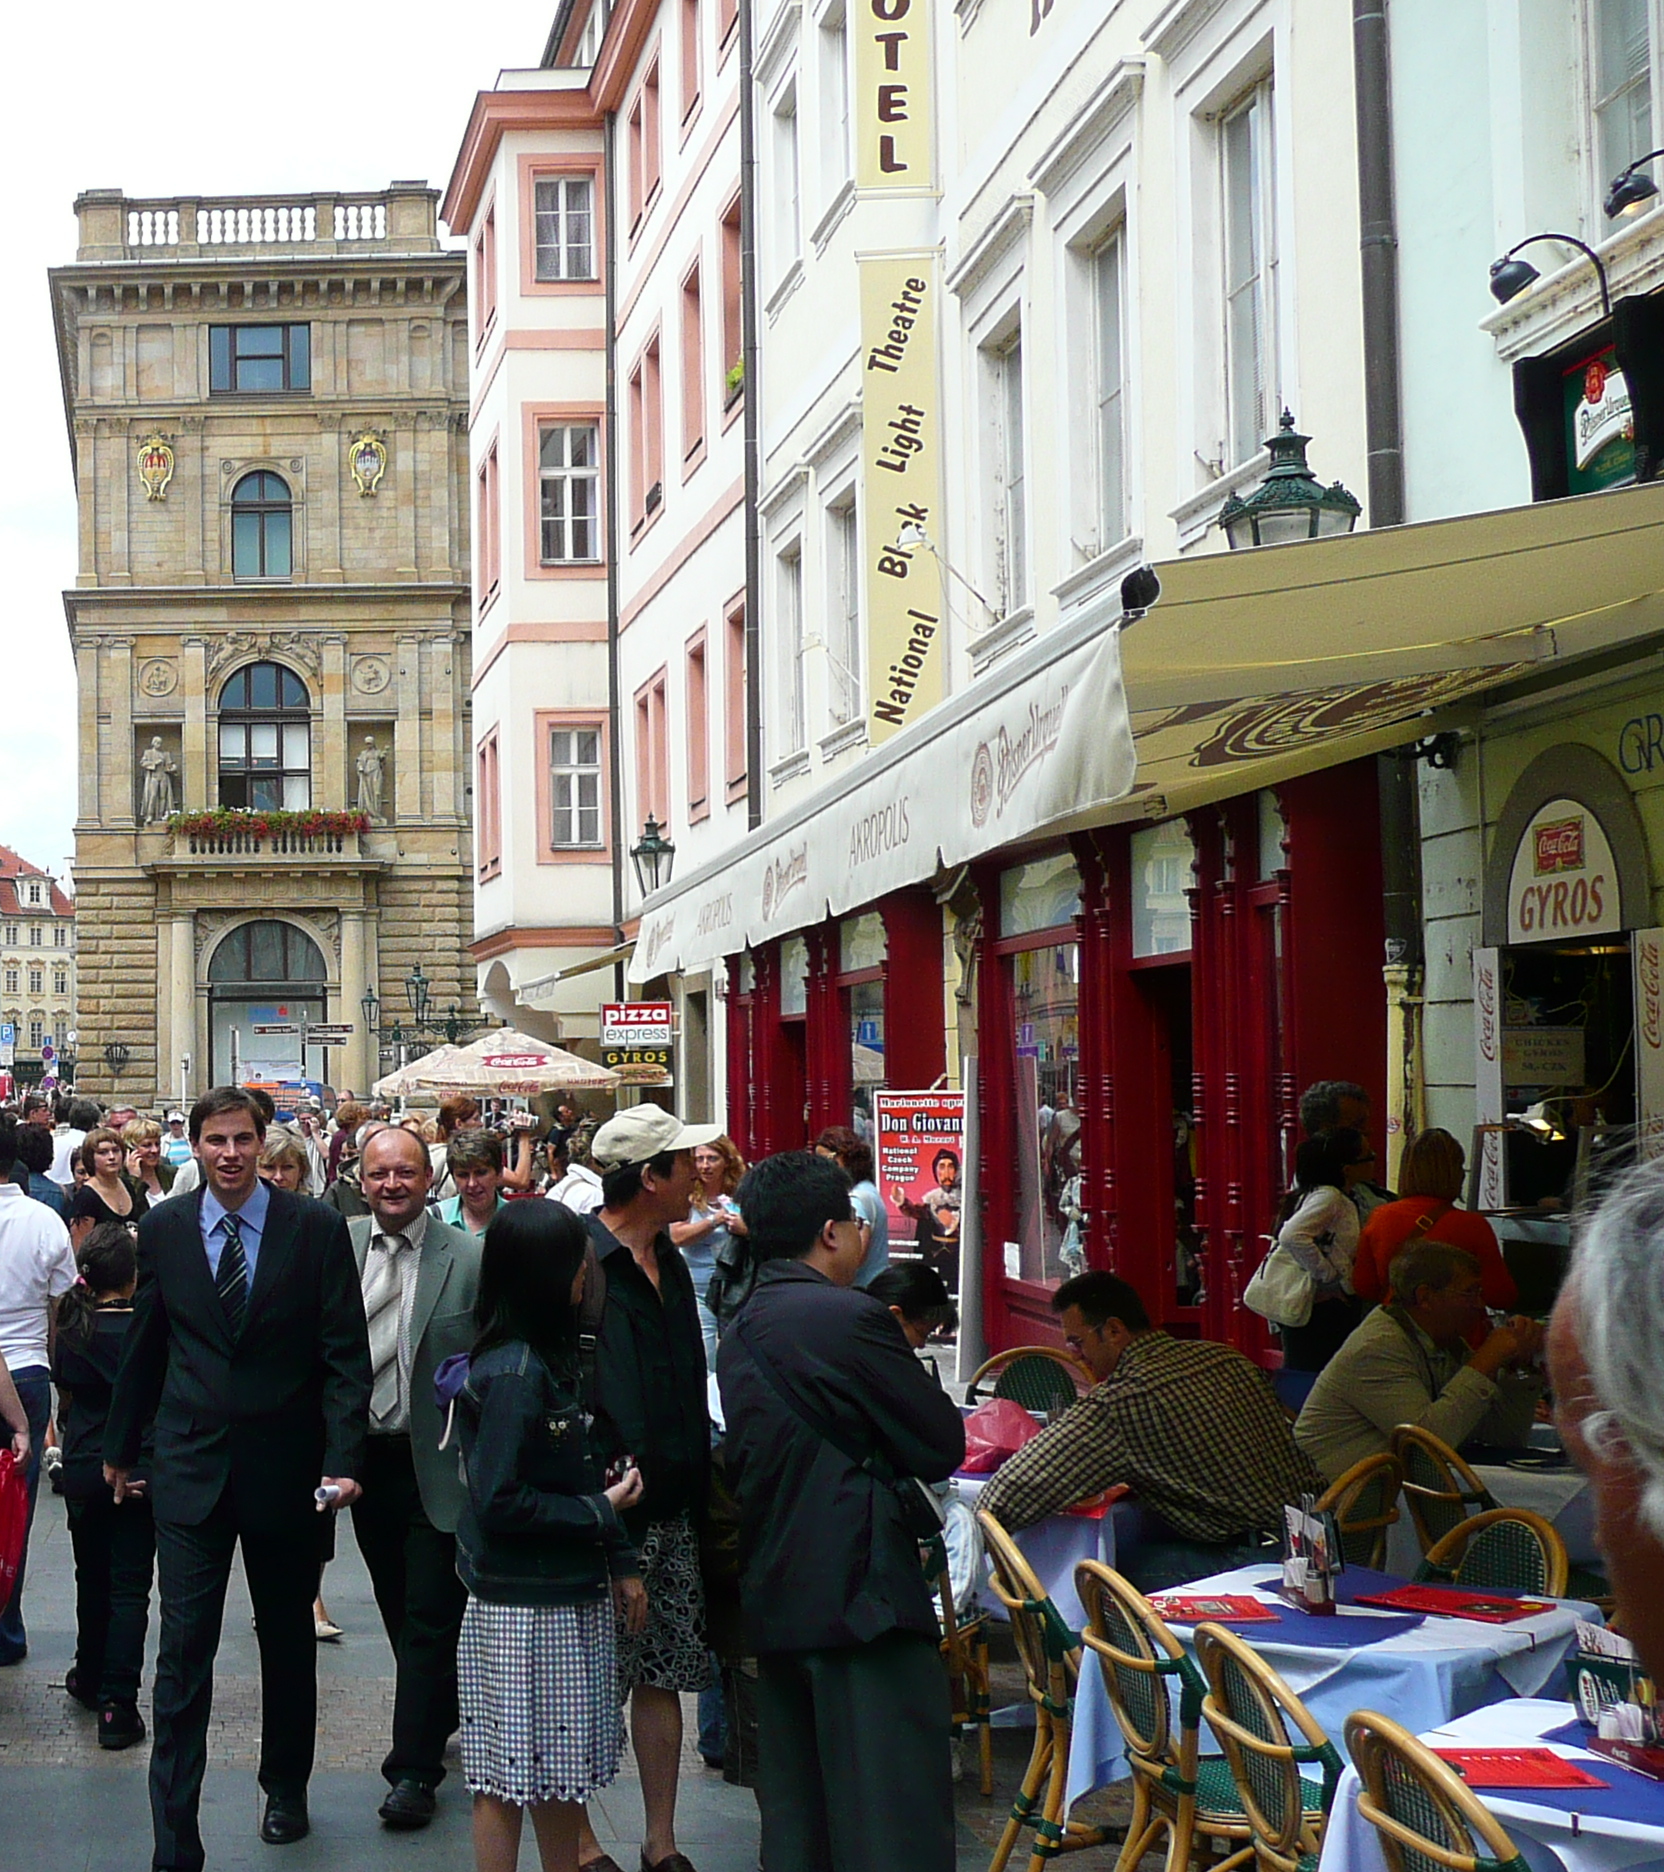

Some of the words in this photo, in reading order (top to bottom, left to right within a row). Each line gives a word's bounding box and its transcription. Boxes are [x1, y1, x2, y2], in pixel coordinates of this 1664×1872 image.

[867, 277, 926, 372] Theatre
[875, 404, 925, 473] Light
[874, 609, 939, 725] National
[849, 796, 909, 868] AKROPOLIS
[1519, 875, 1605, 932] GYROS
[1639, 941, 1662, 1050] Coca-Cola
[605, 1004, 667, 1026] pizza
[1478, 962, 1495, 1062] Coca-Cola
[606, 1028, 667, 1045] express
[490, 1057, 537, 1067] Coca-Cola
[607, 1051, 667, 1063] GYROS
[498, 1079, 540, 1093] Coca-Cola
[879, 1097, 940, 1108] Marionette
[881, 1113, 907, 1131] Don
[882, 1147, 918, 1155] National
[888, 1156, 913, 1164] Czech
[882, 1165, 919, 1174] Company
[886, 1174, 915, 1182] Prague
